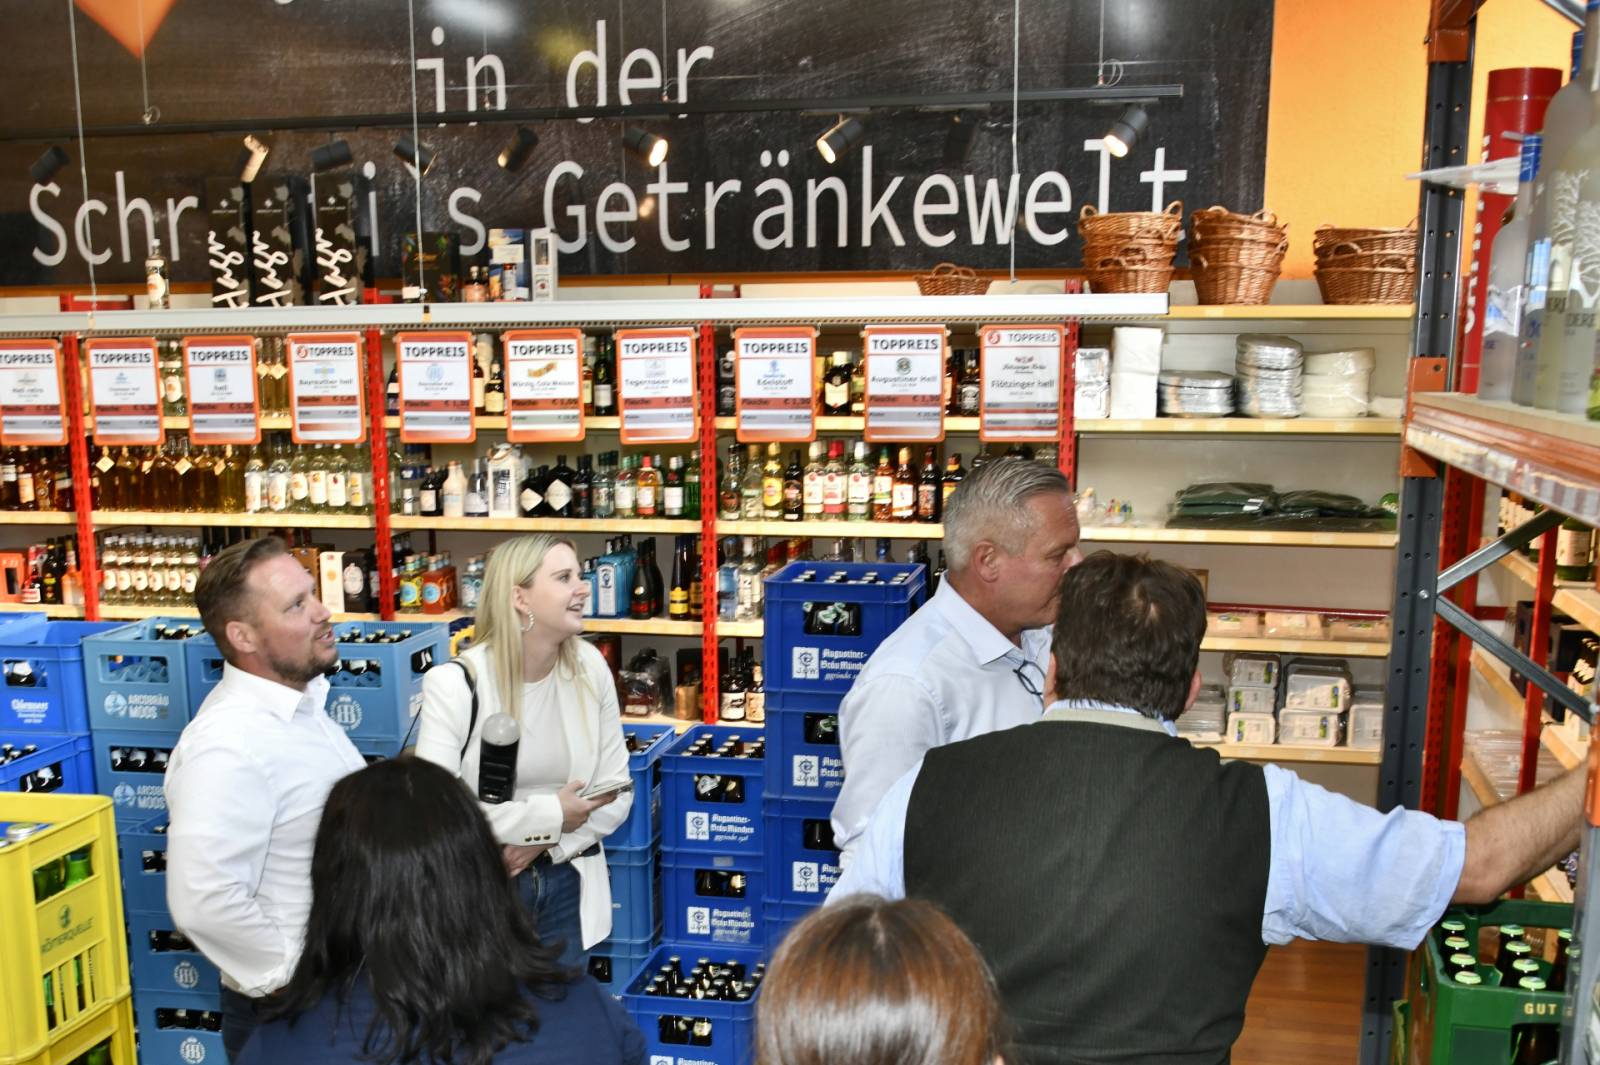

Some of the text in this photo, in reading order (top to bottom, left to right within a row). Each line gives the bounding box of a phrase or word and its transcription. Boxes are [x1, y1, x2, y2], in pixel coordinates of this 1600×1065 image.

[416, 20, 714, 126] in der
[544, 139, 1188, 254] Getränkewelt
[1007, 333, 1057, 343] TOPPREIS
[512, 344, 575, 355] TOPPREIS
[624, 342, 688, 354] TOPPREIS
[743, 342, 808, 353] TOPPREIS
[872, 339, 939, 350] TOPPREIS
[191, 350, 249, 361] TOPPREIS
[309, 346, 355, 357] TOPPREIS
[405, 346, 466, 357] TOPPREIS
[93, 352, 151, 363] TOPPREIS
[128, 706, 158, 719] MOOS
[1524, 1002, 1557, 1016] GUT
